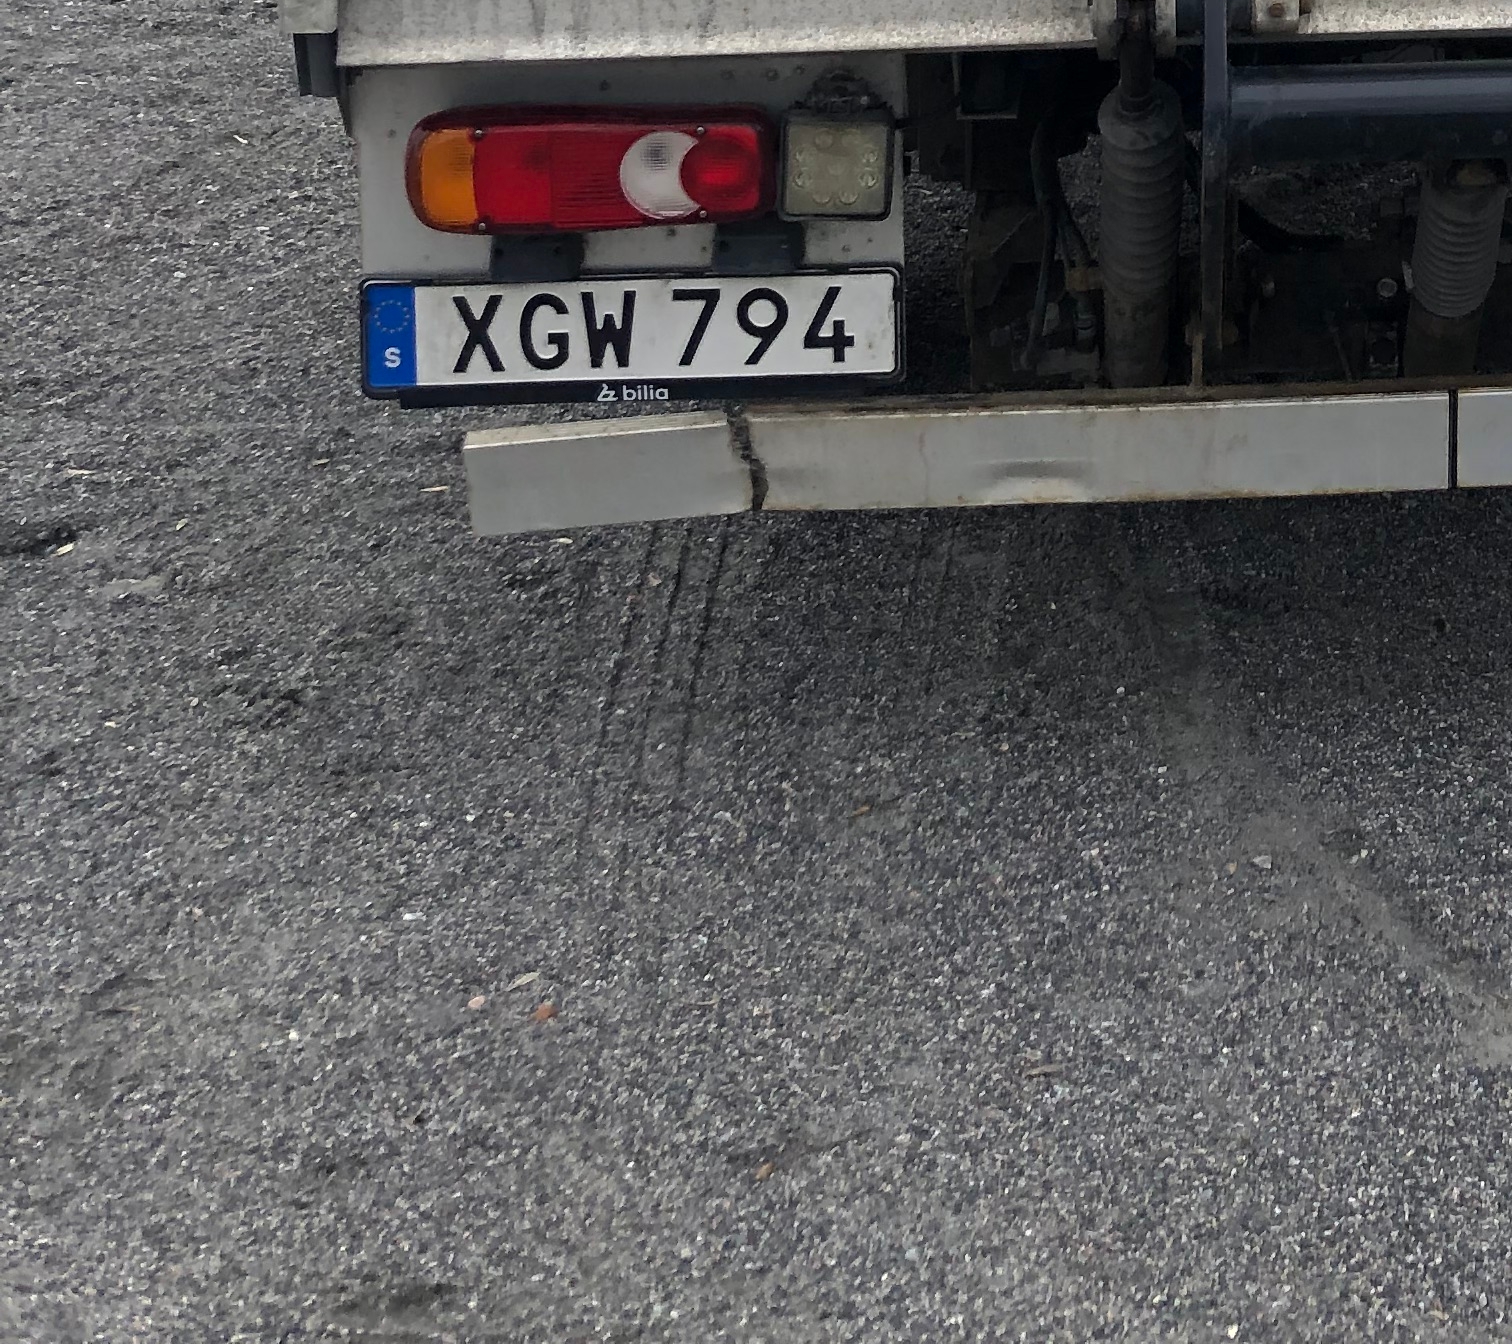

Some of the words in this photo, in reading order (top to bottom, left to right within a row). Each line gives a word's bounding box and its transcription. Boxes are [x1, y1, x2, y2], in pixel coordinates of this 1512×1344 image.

[451, 290, 637, 374] XGW
[671, 285, 856, 366] 794
[383, 345, 402, 369] S
[622, 384, 669, 401] bilia
